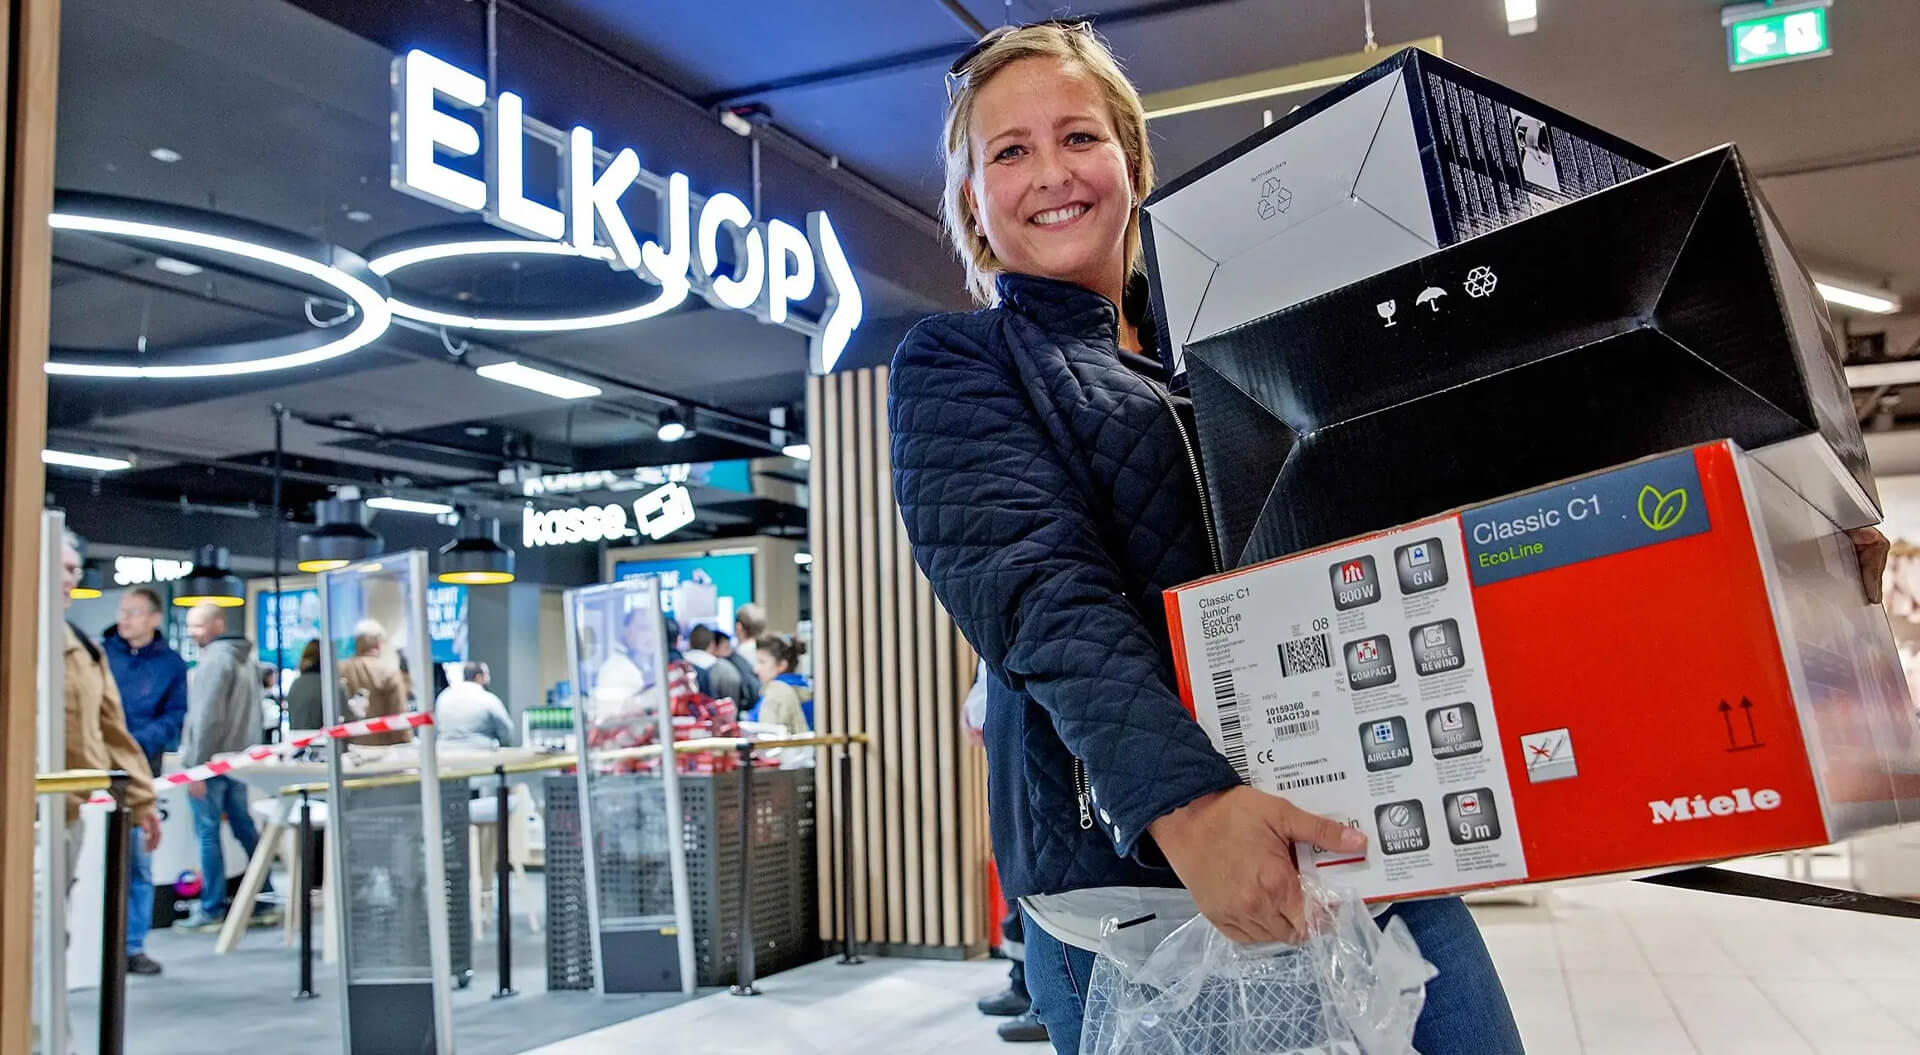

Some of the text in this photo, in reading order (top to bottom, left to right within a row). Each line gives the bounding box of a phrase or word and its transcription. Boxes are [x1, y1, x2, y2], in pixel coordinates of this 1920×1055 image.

[1473, 494, 1601, 545] Classic C1
[1478, 541, 1544, 568] EcoLine
[1413, 569, 1434, 586] GN
[1199, 587, 1250, 609] Classic C1
[1201, 605, 1230, 620] Junior
[1202, 613, 1242, 631] EcoLine
[1312, 617, 1330, 632] 08
[1204, 623, 1239, 639] SBAG1
[1423, 646, 1454, 662] CABLE
[1421, 655, 1459, 673] REWIND
[1351, 665, 1392, 682] COMPACT
[1367, 747, 1409, 763] AIRCLEAN
[1648, 788, 1782, 825] Miele
[1385, 828, 1422, 841] ROTARY
[1459, 820, 1491, 841] 9 m
[1386, 838, 1424, 852] SWITCH
